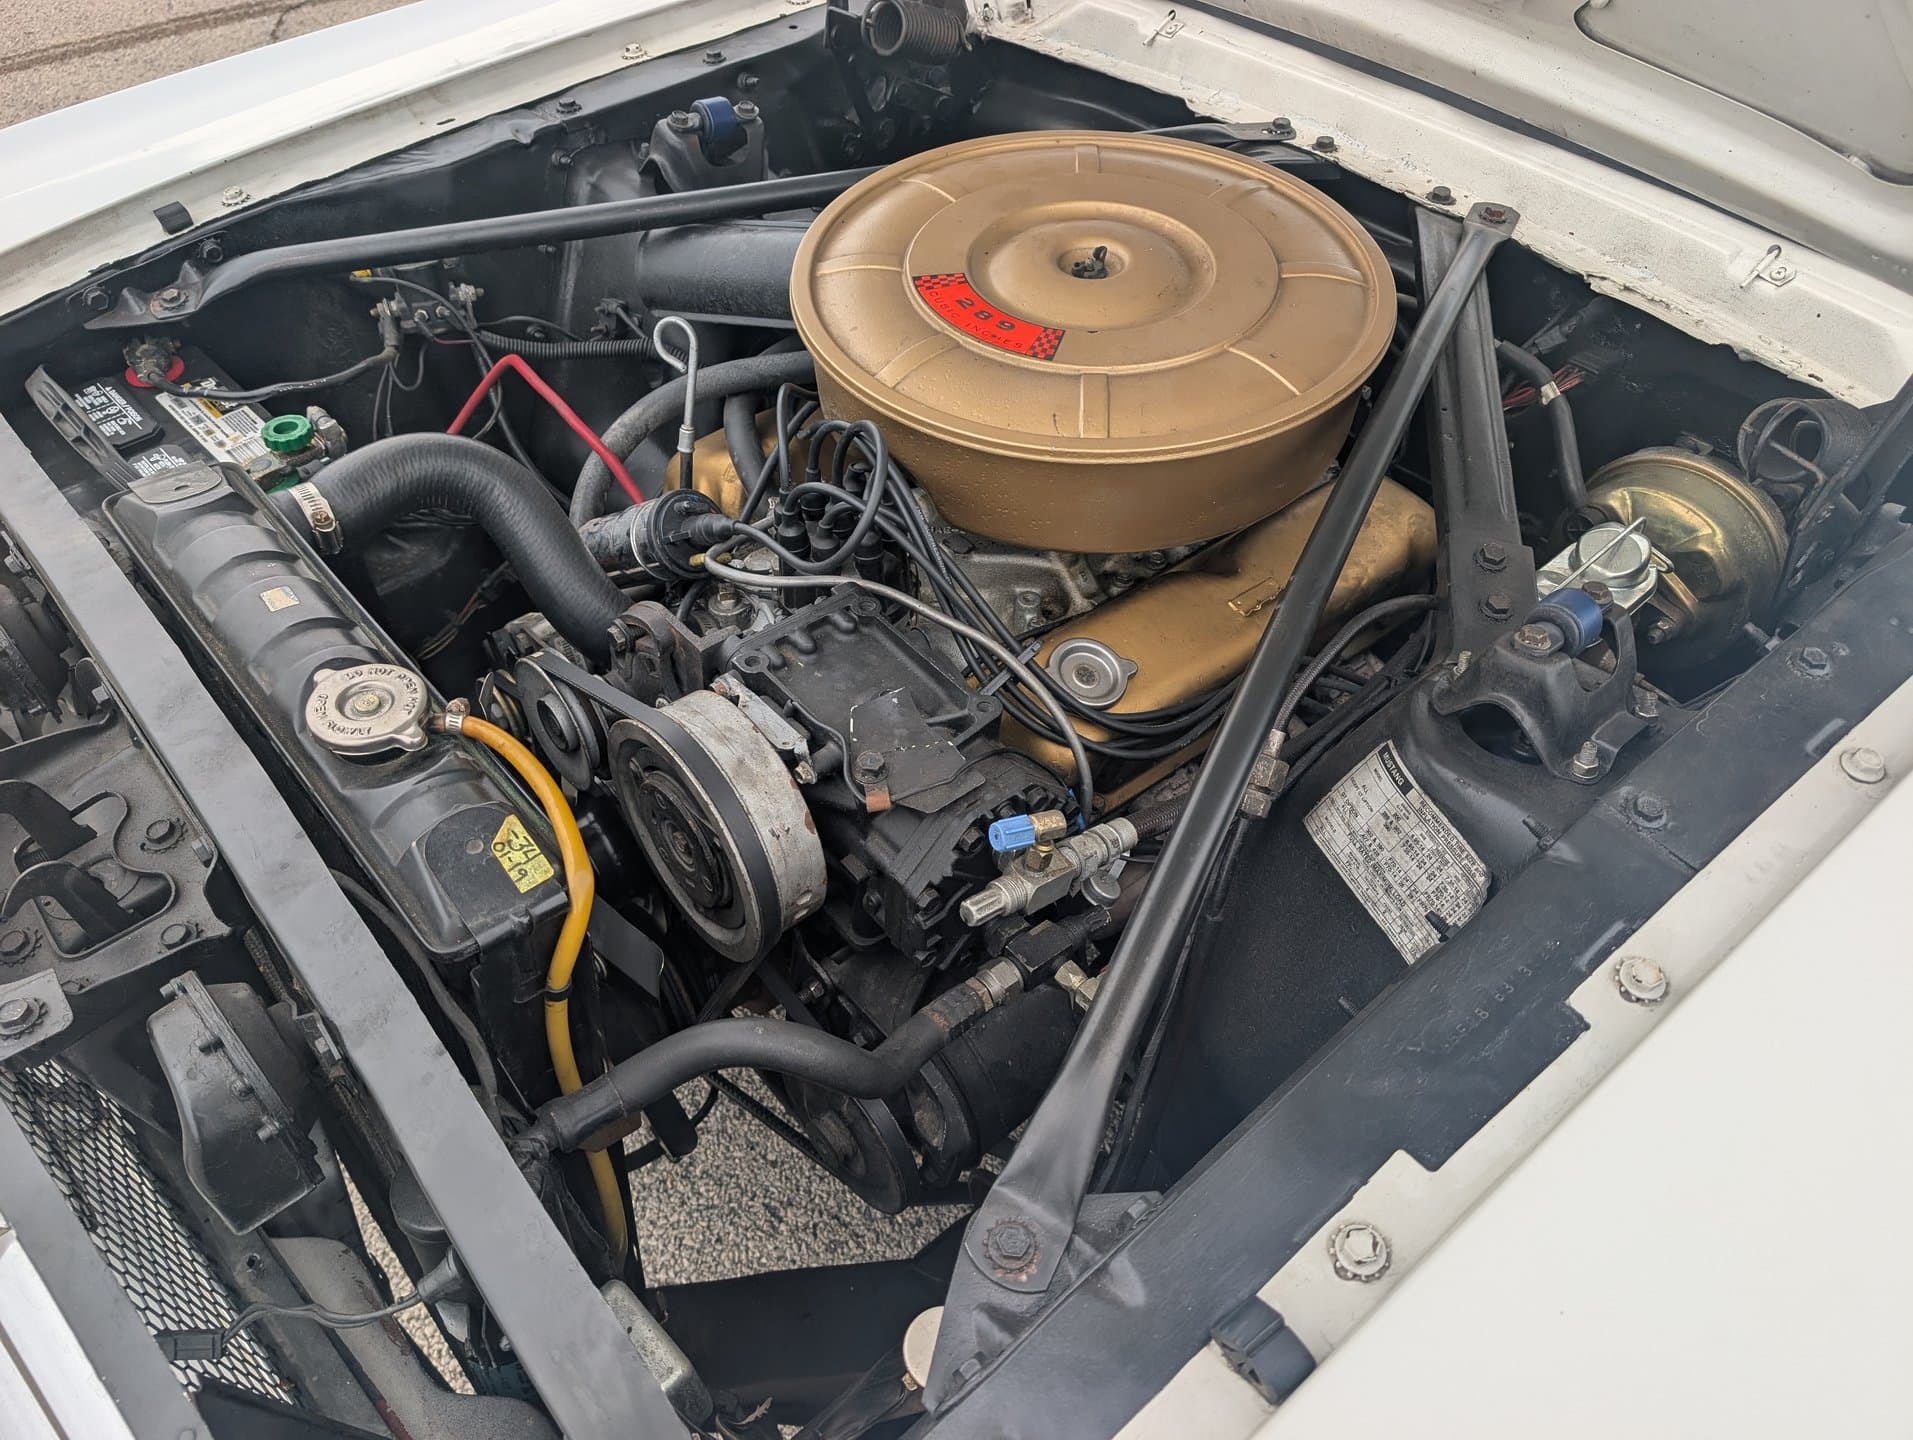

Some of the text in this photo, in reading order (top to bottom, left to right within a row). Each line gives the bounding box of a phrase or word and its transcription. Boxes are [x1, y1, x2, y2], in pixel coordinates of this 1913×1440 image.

[929, 290, 1025, 349] CUBIC INCHES
[956, 297, 1016, 331] 289
[108, 389, 127, 404] DANGER
[125, 406, 143, 421] POISON
[369, 667, 396, 676] NOT
[397, 673, 419, 696] OPEN
[403, 697, 419, 716] HOT
[1382, 751, 1405, 785] MUSTANG
[1416, 806, 1441, 834] INFLATION
[1440, 833, 1464, 861] PRESSURE
[1419, 799, 1455, 842] RECOMMENDED
[1453, 841, 1465, 854] TIRE
[1346, 831, 1359, 847] FULL
[1356, 845, 1372, 864] RATED
[1392, 890, 1406, 907] LOAD
